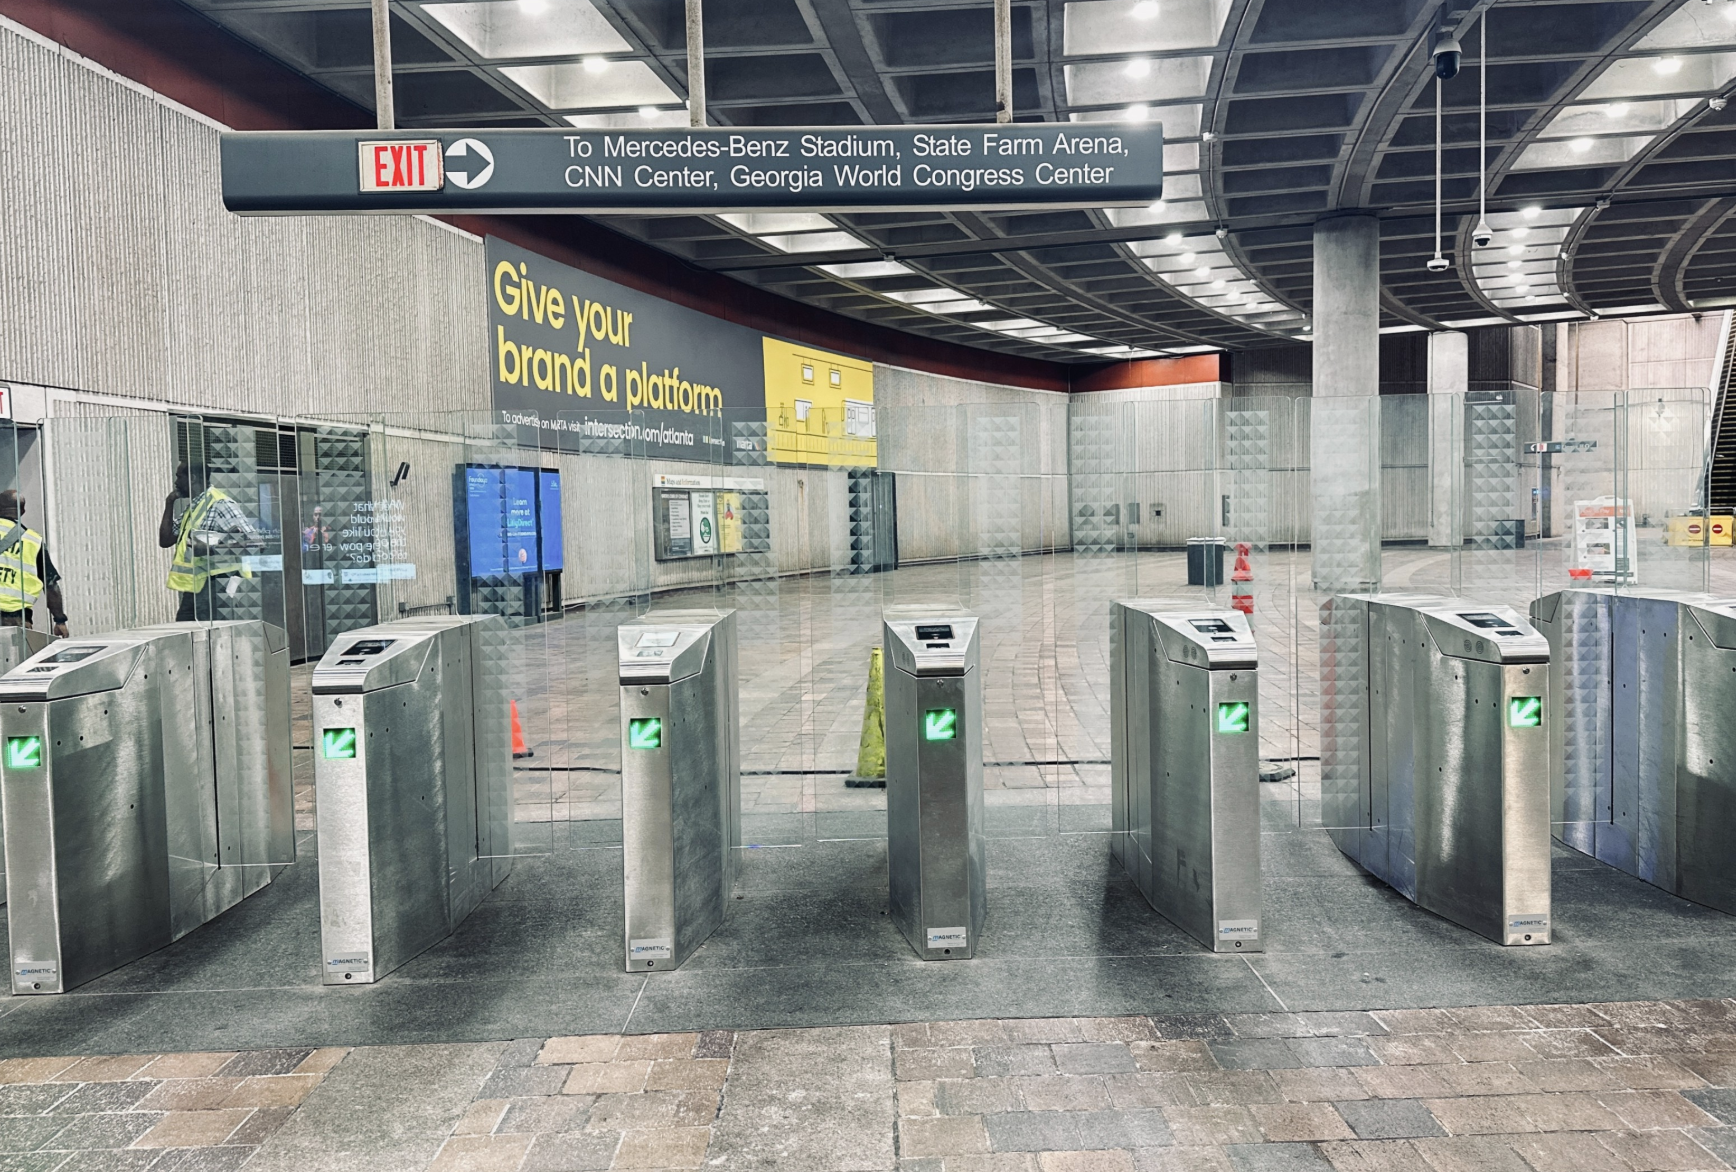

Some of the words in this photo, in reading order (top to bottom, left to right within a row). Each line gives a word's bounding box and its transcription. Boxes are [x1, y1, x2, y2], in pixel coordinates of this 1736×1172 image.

[564, 136, 592, 158] To
[604, 135, 789, 158] Mercedes-Benz
[800, 134, 901, 160] Stadium,
[912, 133, 972, 156] State
[983, 133, 1043, 156] Farm
[1053, 132, 1129, 159] Arena,
[374, 145, 427, 187] EXIT
[564, 165, 623, 188] CNN
[634, 165, 718, 191] Center,
[730, 165, 823, 191] Georgia
[834, 164, 900, 187] World
[912, 163, 1024, 190] Congress
[1035, 163, 1114, 185] Center
[494, 261, 565, 329] Give
[572, 295, 633, 352] your
[498, 326, 591, 397] brand
[600, 363, 616, 402] a
[626, 362, 723, 418] platform
[502, 410, 511, 423] To
[541, 419, 549, 429] on
[568, 421, 580, 432] visit
[511, 508, 524, 516] more
[513, 498, 527, 506] Learn
